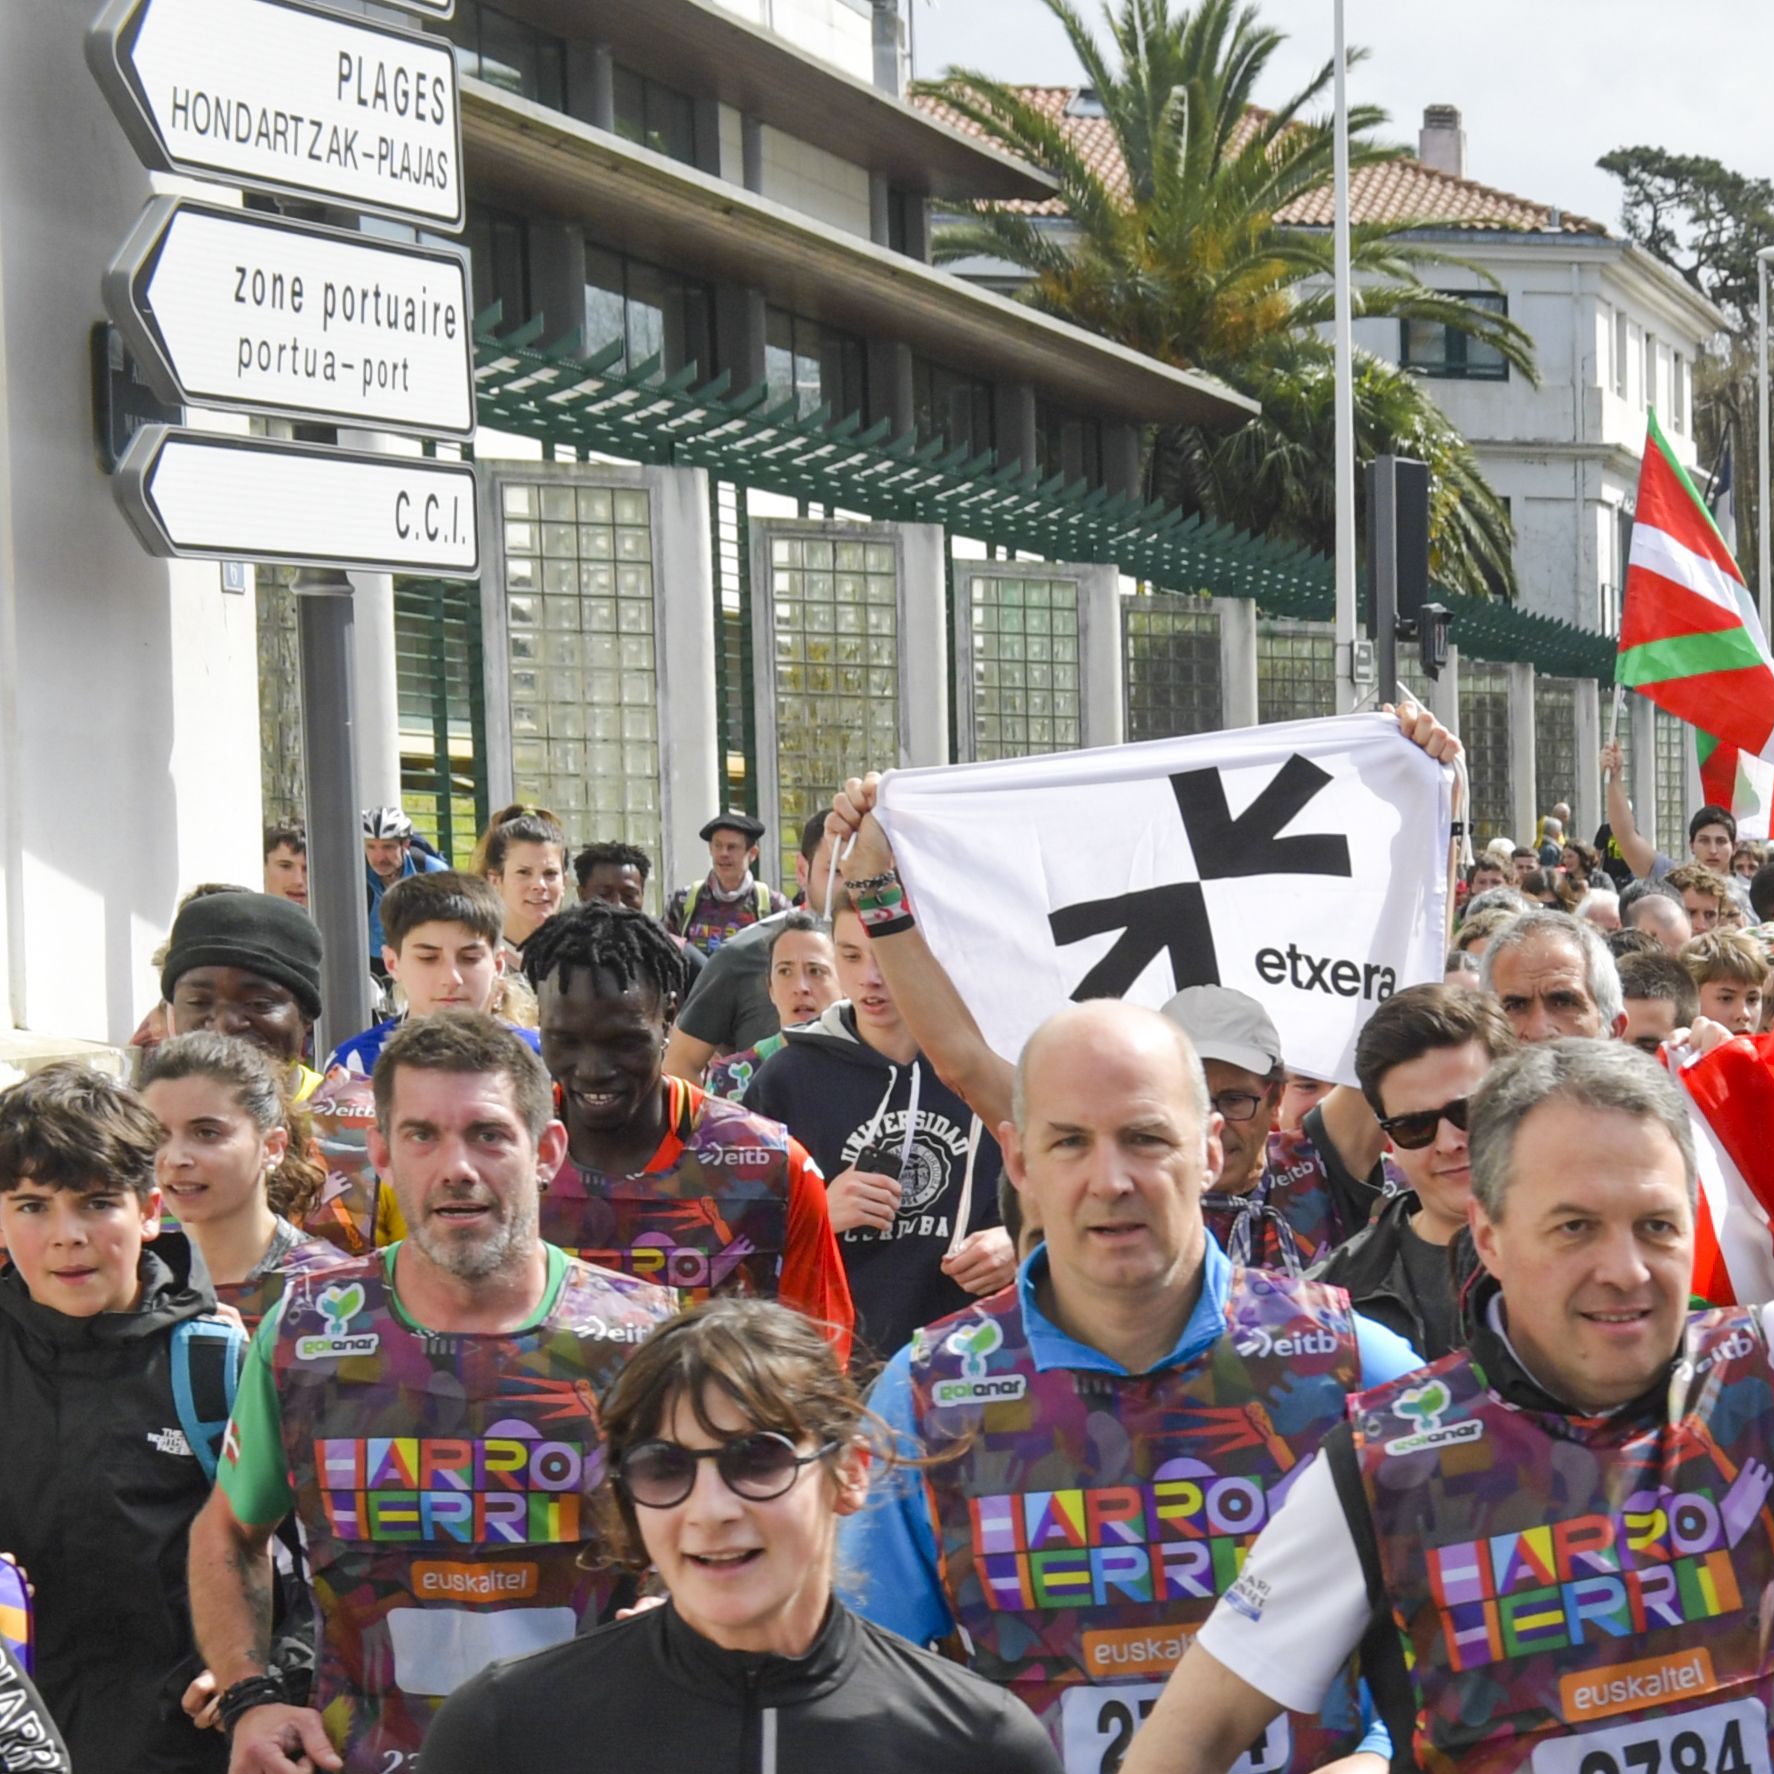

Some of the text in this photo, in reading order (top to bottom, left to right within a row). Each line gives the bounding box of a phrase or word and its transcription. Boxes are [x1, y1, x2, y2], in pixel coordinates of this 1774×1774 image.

[338, 50, 445, 127] PLAGES
[172, 86, 448, 191] HONDARTZAK-PLAJAS
[234, 265, 457, 339] zone portuaire
[238, 336, 409, 396] portua-port
[395, 490, 467, 545] C.C.I.
[1255, 944, 1397, 1001] etxera
[724, 1147, 770, 1166] eitb
[1277, 1159, 1315, 1187] eitb
[1274, 1329, 1338, 1357] eitb
[422, 1567, 528, 1594] euskaltel
[1573, 1663, 1706, 1712] euskaltel
